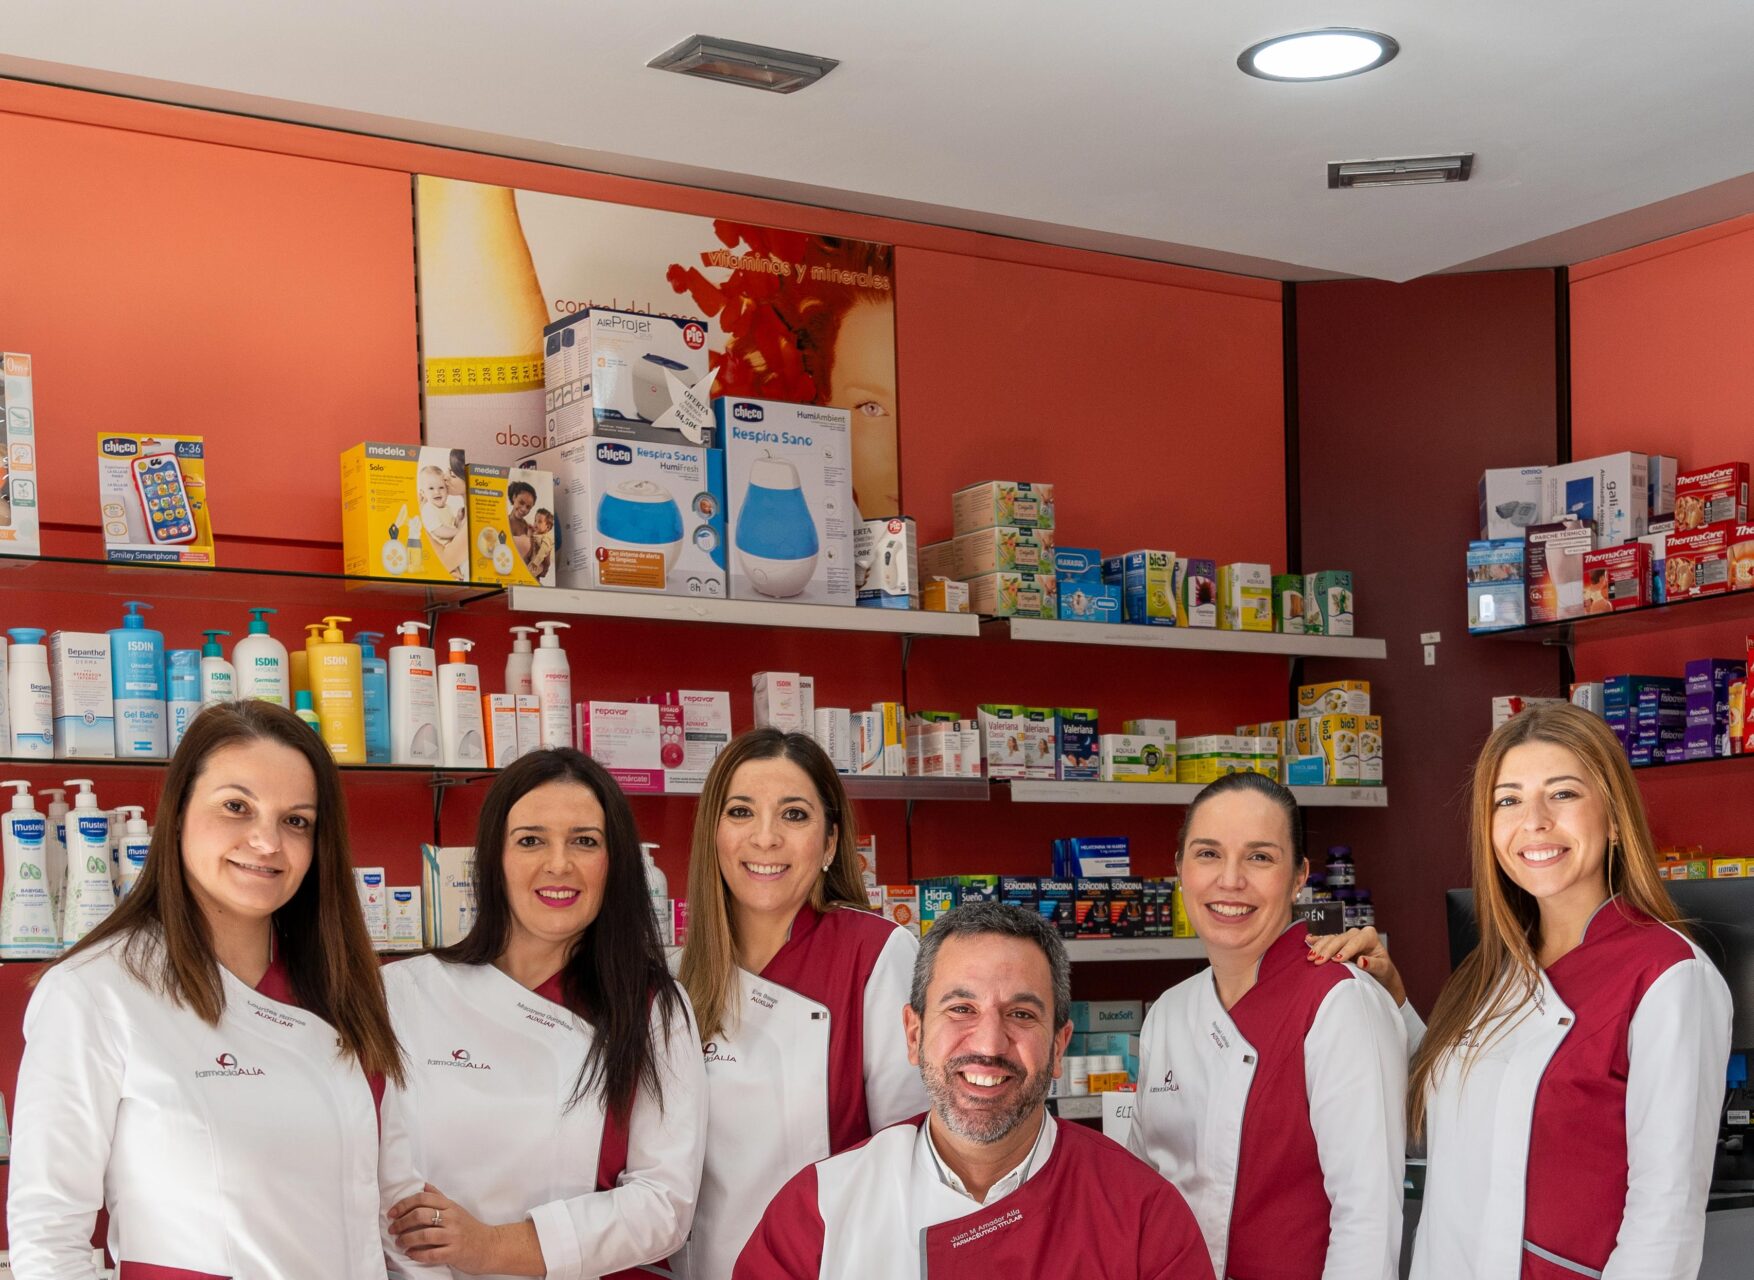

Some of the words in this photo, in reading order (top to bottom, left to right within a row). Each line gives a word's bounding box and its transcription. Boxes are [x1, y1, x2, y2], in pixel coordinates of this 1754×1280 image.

[707, 249, 790, 277] vitaminas
[796, 262, 806, 282] y
[810, 266, 891, 290] minerales
[437, 369, 445, 383] 235
[452, 368, 460, 383] 236
[468, 368, 476, 382] 237
[483, 367, 491, 381] 238
[497, 366, 505, 381] 239
[683, 390, 708, 416] OFERTA
[734, 405, 762, 420] chicco
[797, 410, 846, 423] HumiAmbient
[732, 427, 779, 443] Respira
[782, 432, 813, 446] Sano
[103, 439, 137, 454] chicco
[178, 443, 202, 453] 6-36
[368, 445, 405, 457] medela
[598, 446, 631, 462] chicco
[637, 447, 672, 460] Respira
[674, 451, 698, 462] Sano
[369, 463, 384, 472] Solo
[474, 467, 499, 475] medela
[660, 462, 699, 473] HumiFresh
[1677, 467, 1734, 485] ThermaCare
[1534, 533, 1558, 541] PARCHE
[1667, 530, 1724, 547] ThermaCare
[110, 551, 135, 561] Smiley
[136, 551, 178, 561] Smartphone
[1149, 553, 1167, 567] bio3
[1585, 548, 1636, 564] ThermaCare
[128, 641, 154, 651] ISDIN
[67, 648, 106, 657] Bepanthol
[255, 657, 279, 666] ISDIN
[323, 656, 348, 665] ISDIN
[211, 673, 231, 681] ISDIN
[124, 711, 137, 719] Gel
[595, 708, 628, 716] repavar
[988, 721, 1019, 731] Valeriana
[1340, 717, 1356, 729] bio3
[1063, 724, 1094, 734] Valeriana
[14, 823, 44, 831] Mustela
[80, 821, 107, 829] Mustela
[1004, 880, 1037, 890] SOÑODINA
[1041, 880, 1073, 890] SOÑODINA
[1078, 880, 1109, 890] SOÑODINA
[1112, 880, 1143, 890] SOÑODINA
[925, 890, 952, 900] Hidra
[962, 892, 983, 902] Sueño
[925, 900, 941, 911] Sal
[254, 1010, 294, 1028] AUXILIAR
[526, 1014, 555, 1028] AUXILIAR
[1099, 1011, 1133, 1020] DulceSoft
[998, 1214, 1023, 1229] TITULAR
[950, 1232, 968, 1243] Juan
[969, 1228, 976, 1236] M
[978, 1215, 1005, 1231] Amador
